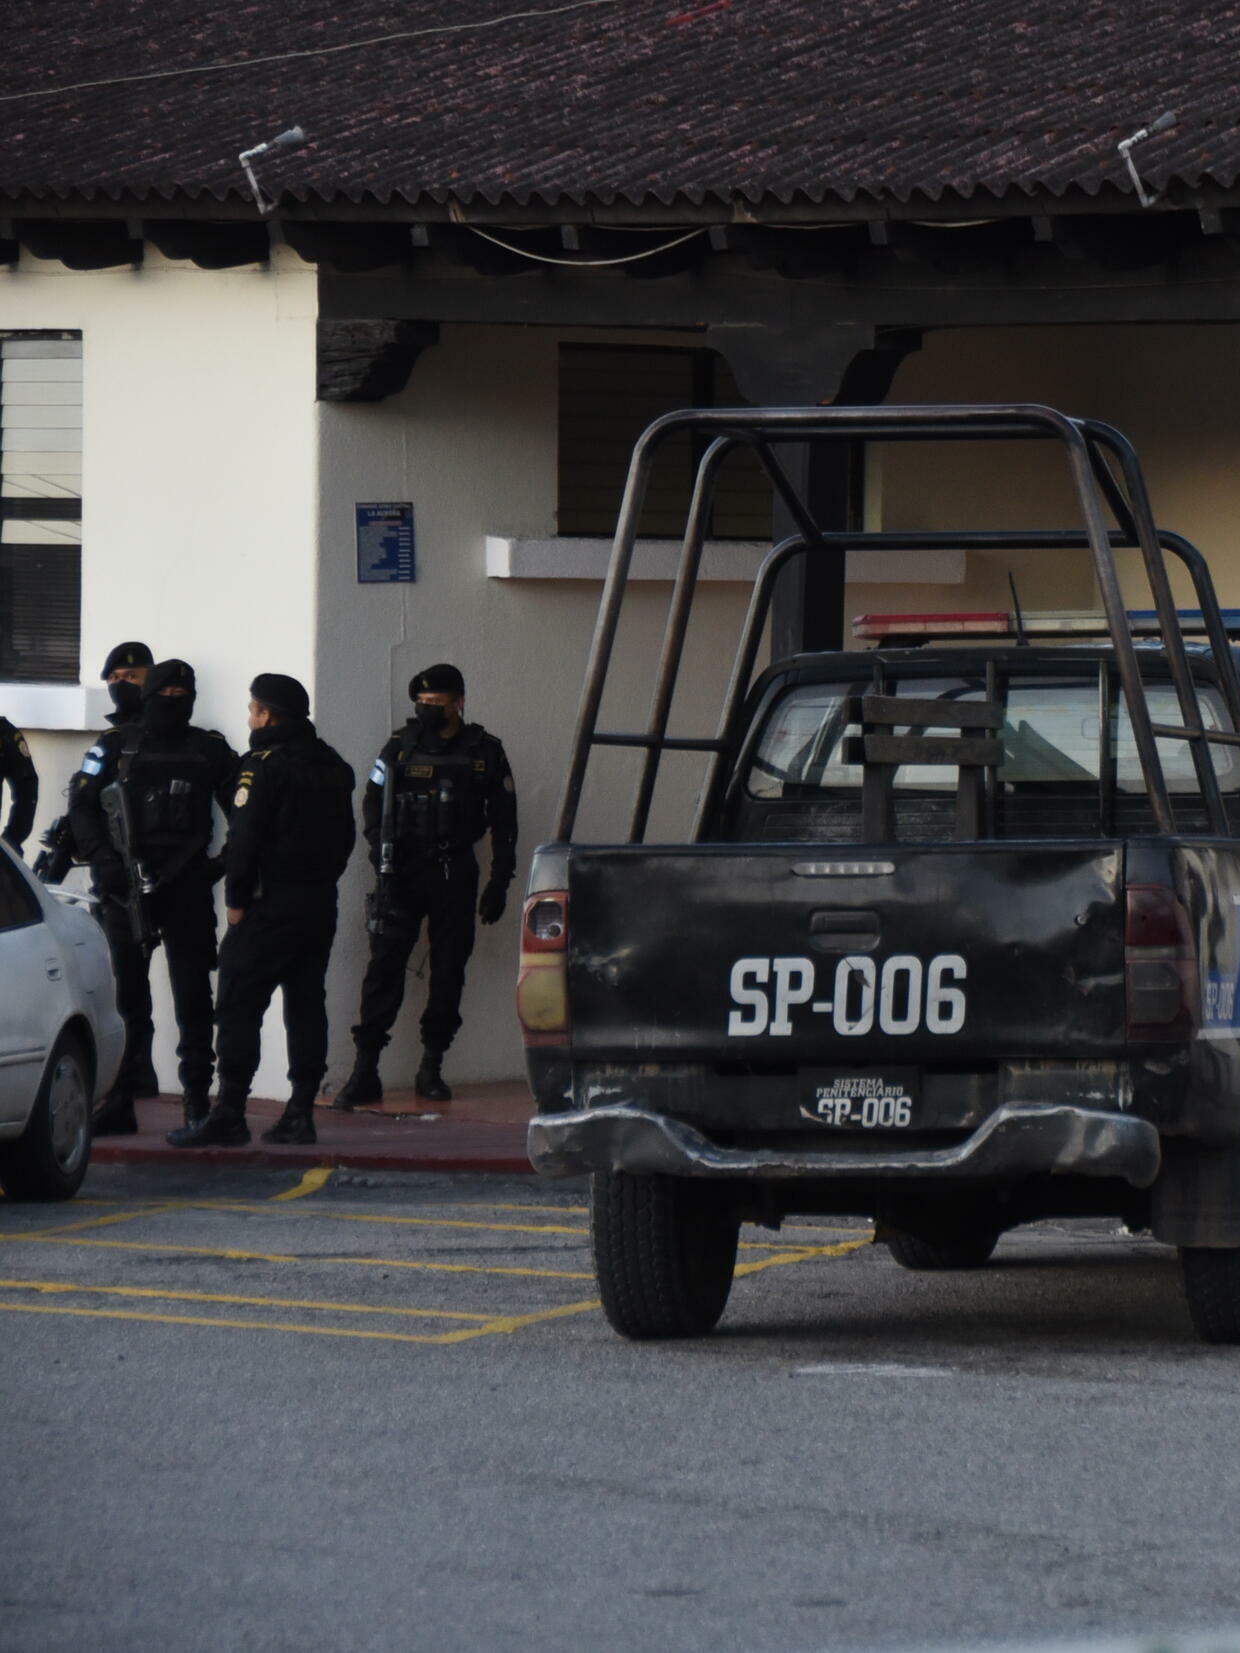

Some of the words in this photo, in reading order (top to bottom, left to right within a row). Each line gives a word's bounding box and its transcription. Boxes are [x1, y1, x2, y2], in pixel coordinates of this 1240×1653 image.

[727, 953, 968, 1036] SP-006
[816, 1087, 904, 1098] PENITENCIARIO
[833, 1078, 884, 1089] SISTEMA
[818, 1097, 912, 1128] SP-006
